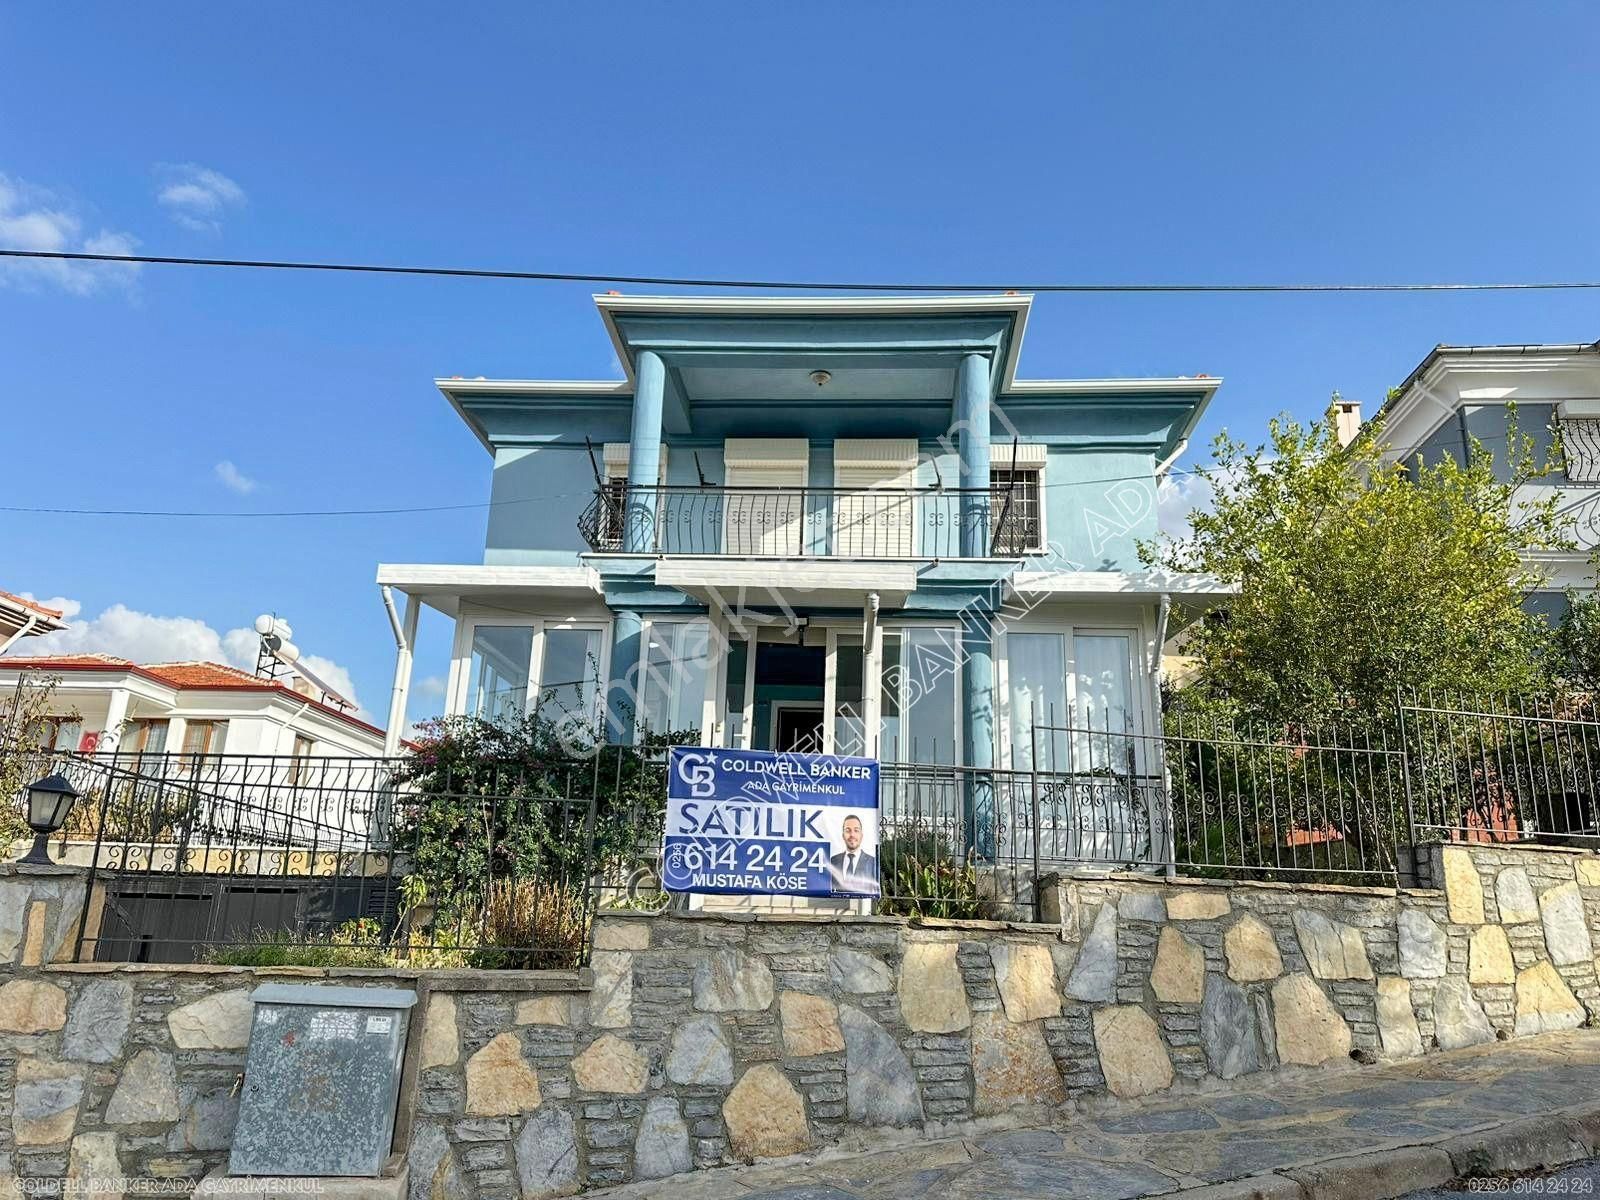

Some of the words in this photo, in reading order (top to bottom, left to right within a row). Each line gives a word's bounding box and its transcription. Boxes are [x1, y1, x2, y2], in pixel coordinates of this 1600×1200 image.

[722, 759, 806, 776] COLDWELL
[810, 764, 871, 780] BANKER
[747, 781, 770, 791] ADA
[772, 781, 845, 795] GAYRİMENKUL
[679, 803, 824, 839] SATILIK
[684, 842, 737, 870] 614
[746, 844, 783, 872] 24
[790, 846, 827, 874] 24
[692, 873, 762, 889] MUSTAFA
[766, 872, 807, 890] KÖSE
